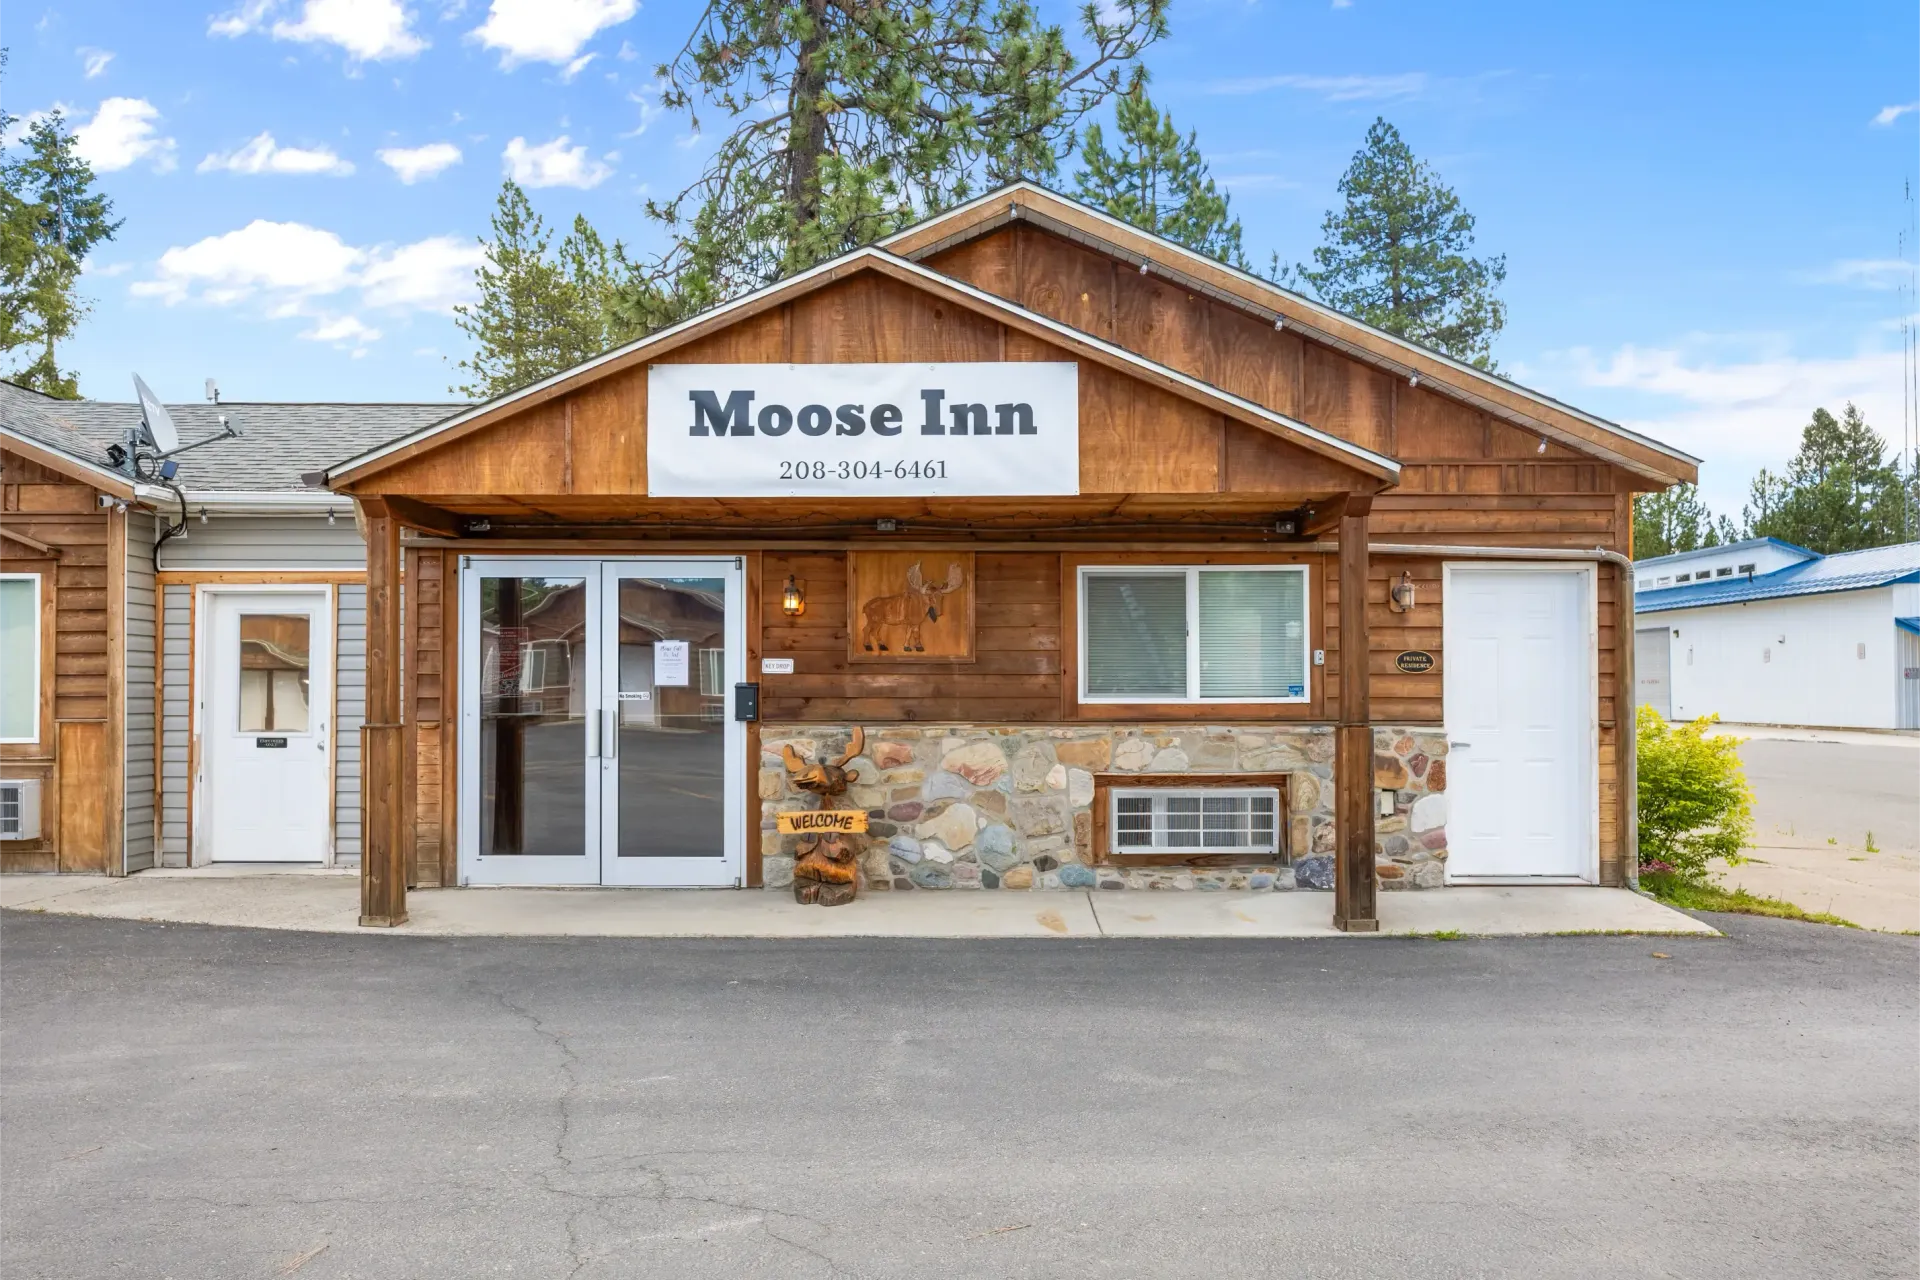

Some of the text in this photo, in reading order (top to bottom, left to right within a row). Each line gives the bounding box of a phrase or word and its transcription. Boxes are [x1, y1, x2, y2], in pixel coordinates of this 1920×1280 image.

[689, 389, 1038, 437] Moose Inn
[779, 460, 949, 480] 208-304-6461
[790, 813, 854, 831] WELCOME
